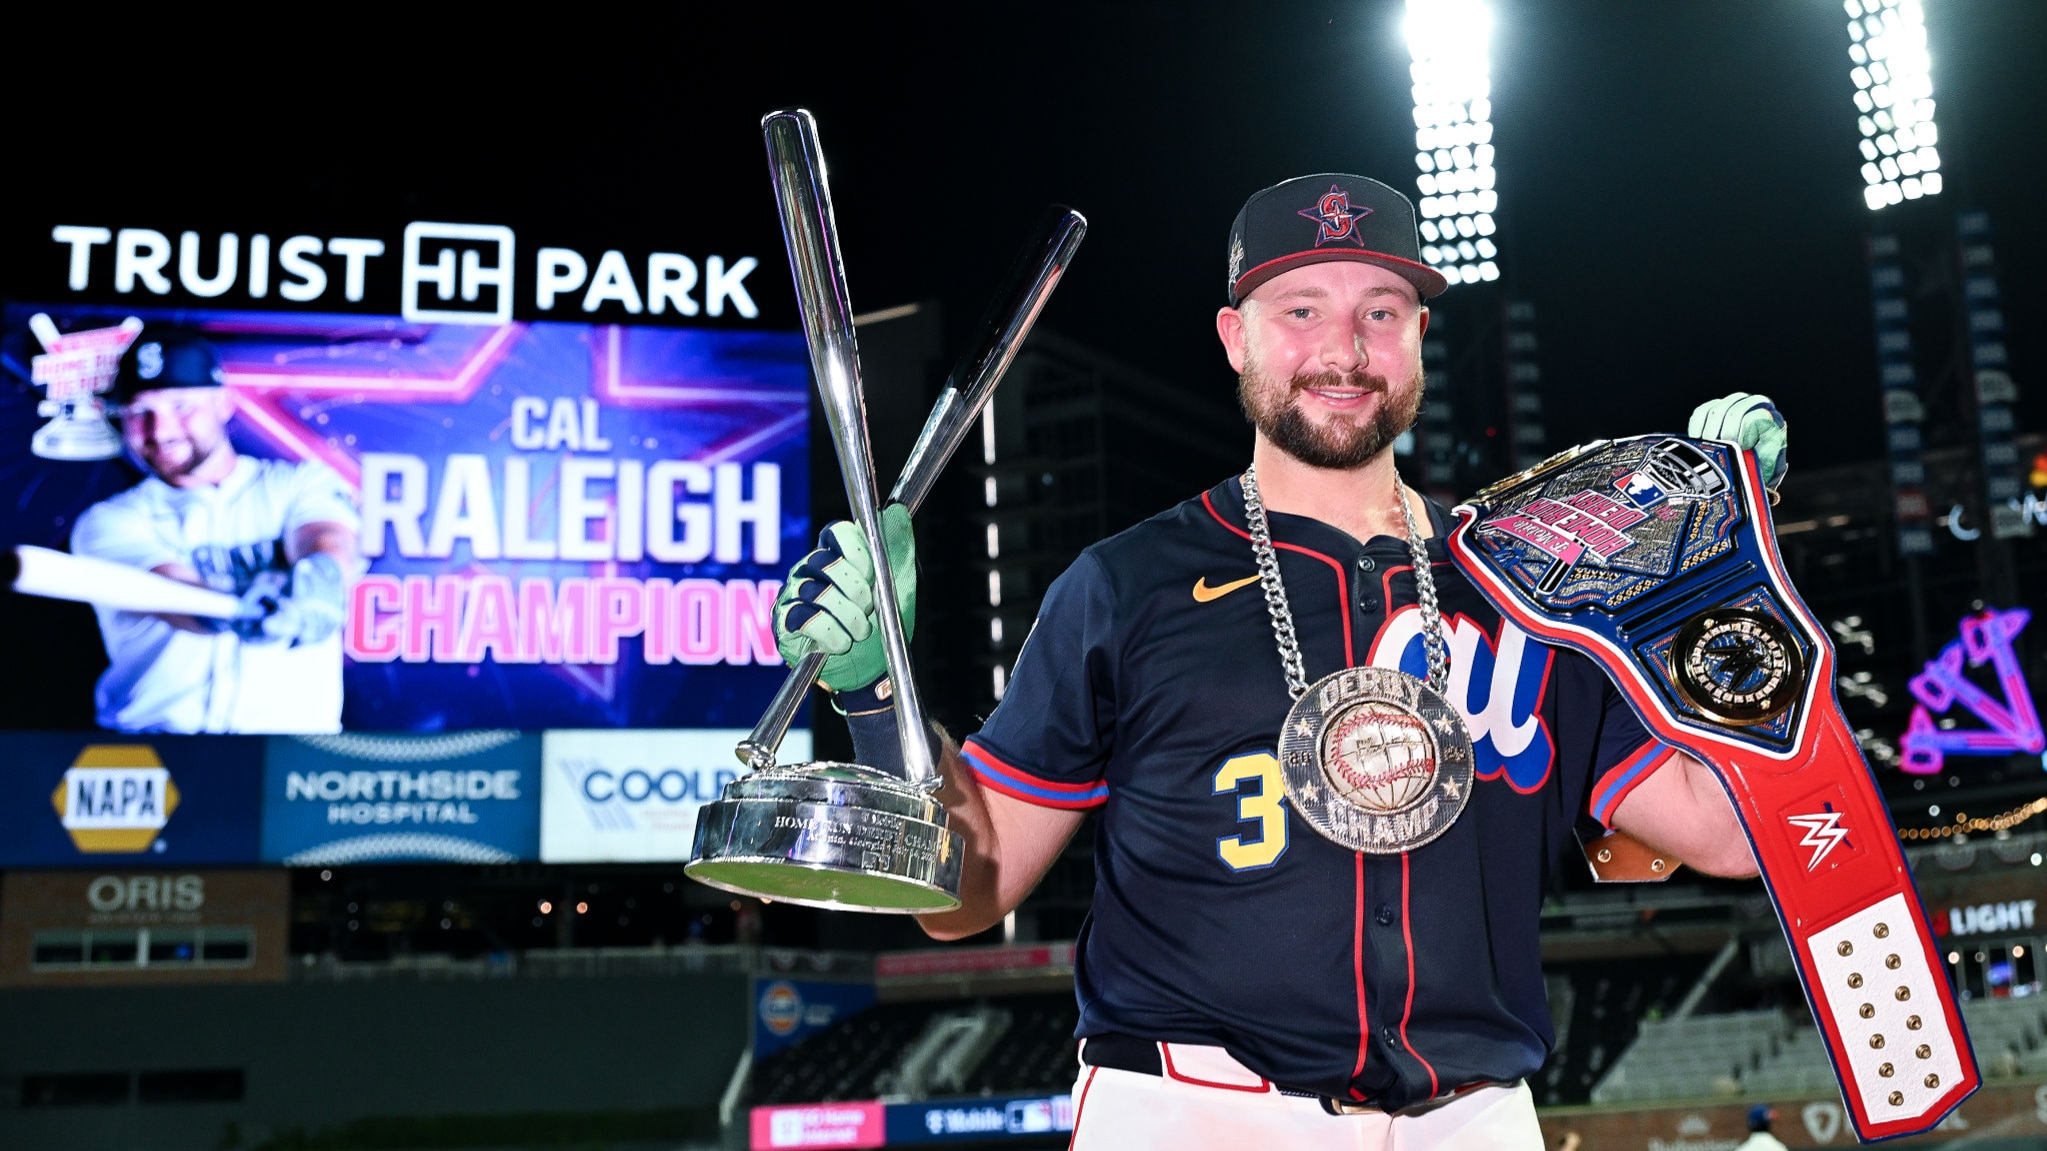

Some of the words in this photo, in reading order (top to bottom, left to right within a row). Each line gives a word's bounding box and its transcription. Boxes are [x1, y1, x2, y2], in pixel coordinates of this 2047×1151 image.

[52, 225, 385, 302] TRUIST
[536, 247, 760, 319] PARK
[510, 395, 611, 451] CAL
[360, 452, 782, 565] RALEIGH
[1521, 498, 1577, 527] RUN
[1567, 489, 1645, 531] DERBY
[1511, 518, 1558, 546] Mobile
[1559, 513, 1627, 558] HOME
[344, 573, 785, 666] CHAMPION
[1319, 672, 1423, 714] DERBY
[76, 777, 156, 818] NAPA
[285, 770, 519, 802] NORTHSIDE
[327, 805, 478, 825] HOSPITAL
[774, 815, 817, 830] HOME
[1211, 749, 1290, 873] 3
[1327, 797, 1439, 842] CHAMP
[88, 874, 205, 911] ORIS
[1949, 899, 2037, 936] LIGHT
